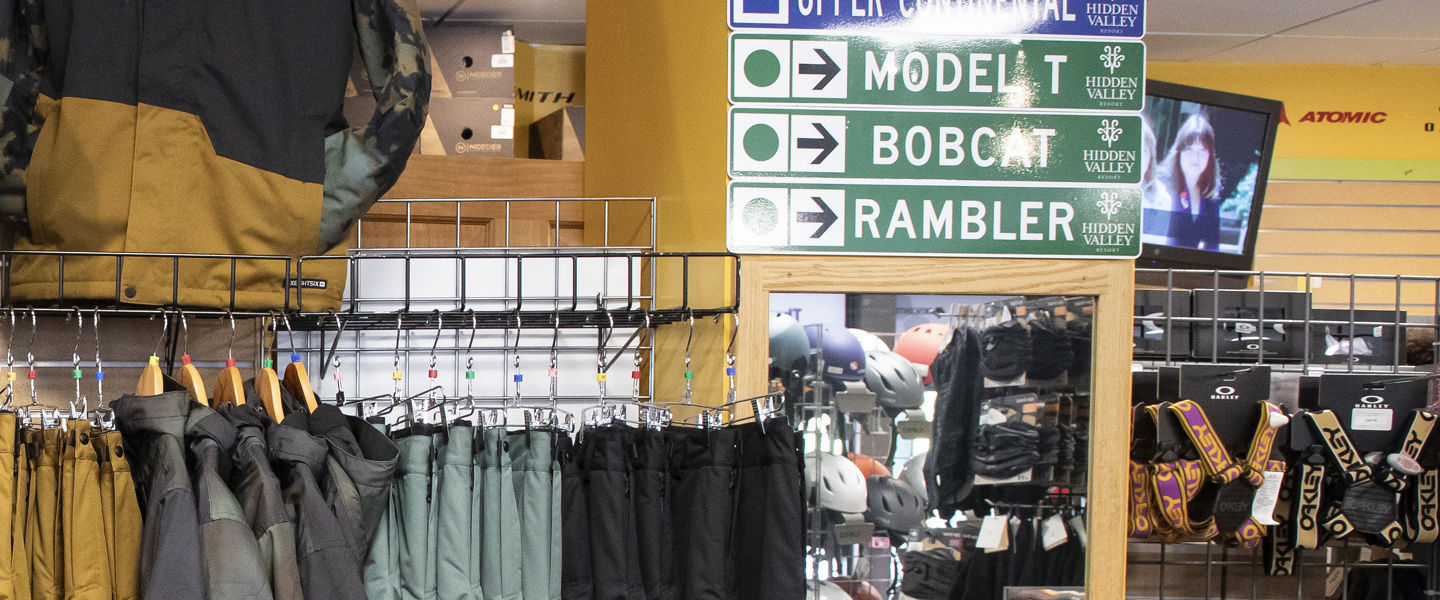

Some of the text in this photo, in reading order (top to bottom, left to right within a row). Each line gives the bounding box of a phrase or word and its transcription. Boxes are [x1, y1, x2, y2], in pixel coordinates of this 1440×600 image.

[1086, 3, 1139, 15] HIDDEN
[1087, 15, 1137, 27] VALLEY
[864, 51, 1068, 94] MODEL T
[1085, 76, 1138, 88] HIDDEN
[515, 87, 575, 103] MITH
[1086, 88, 1136, 100] VALLEY
[1298, 111, 1387, 124] ATOMIC
[873, 125, 1057, 169] BOBCAT
[1083, 149, 1136, 161] HIDDEN
[1084, 161, 1135, 173] VALLEY
[855, 198, 1074, 241] RAMBLER
[1082, 222, 1135, 234] HIDDEN
[1083, 234, 1134, 246] VALLEY
[1300, 464, 1321, 531] OAKLEY
